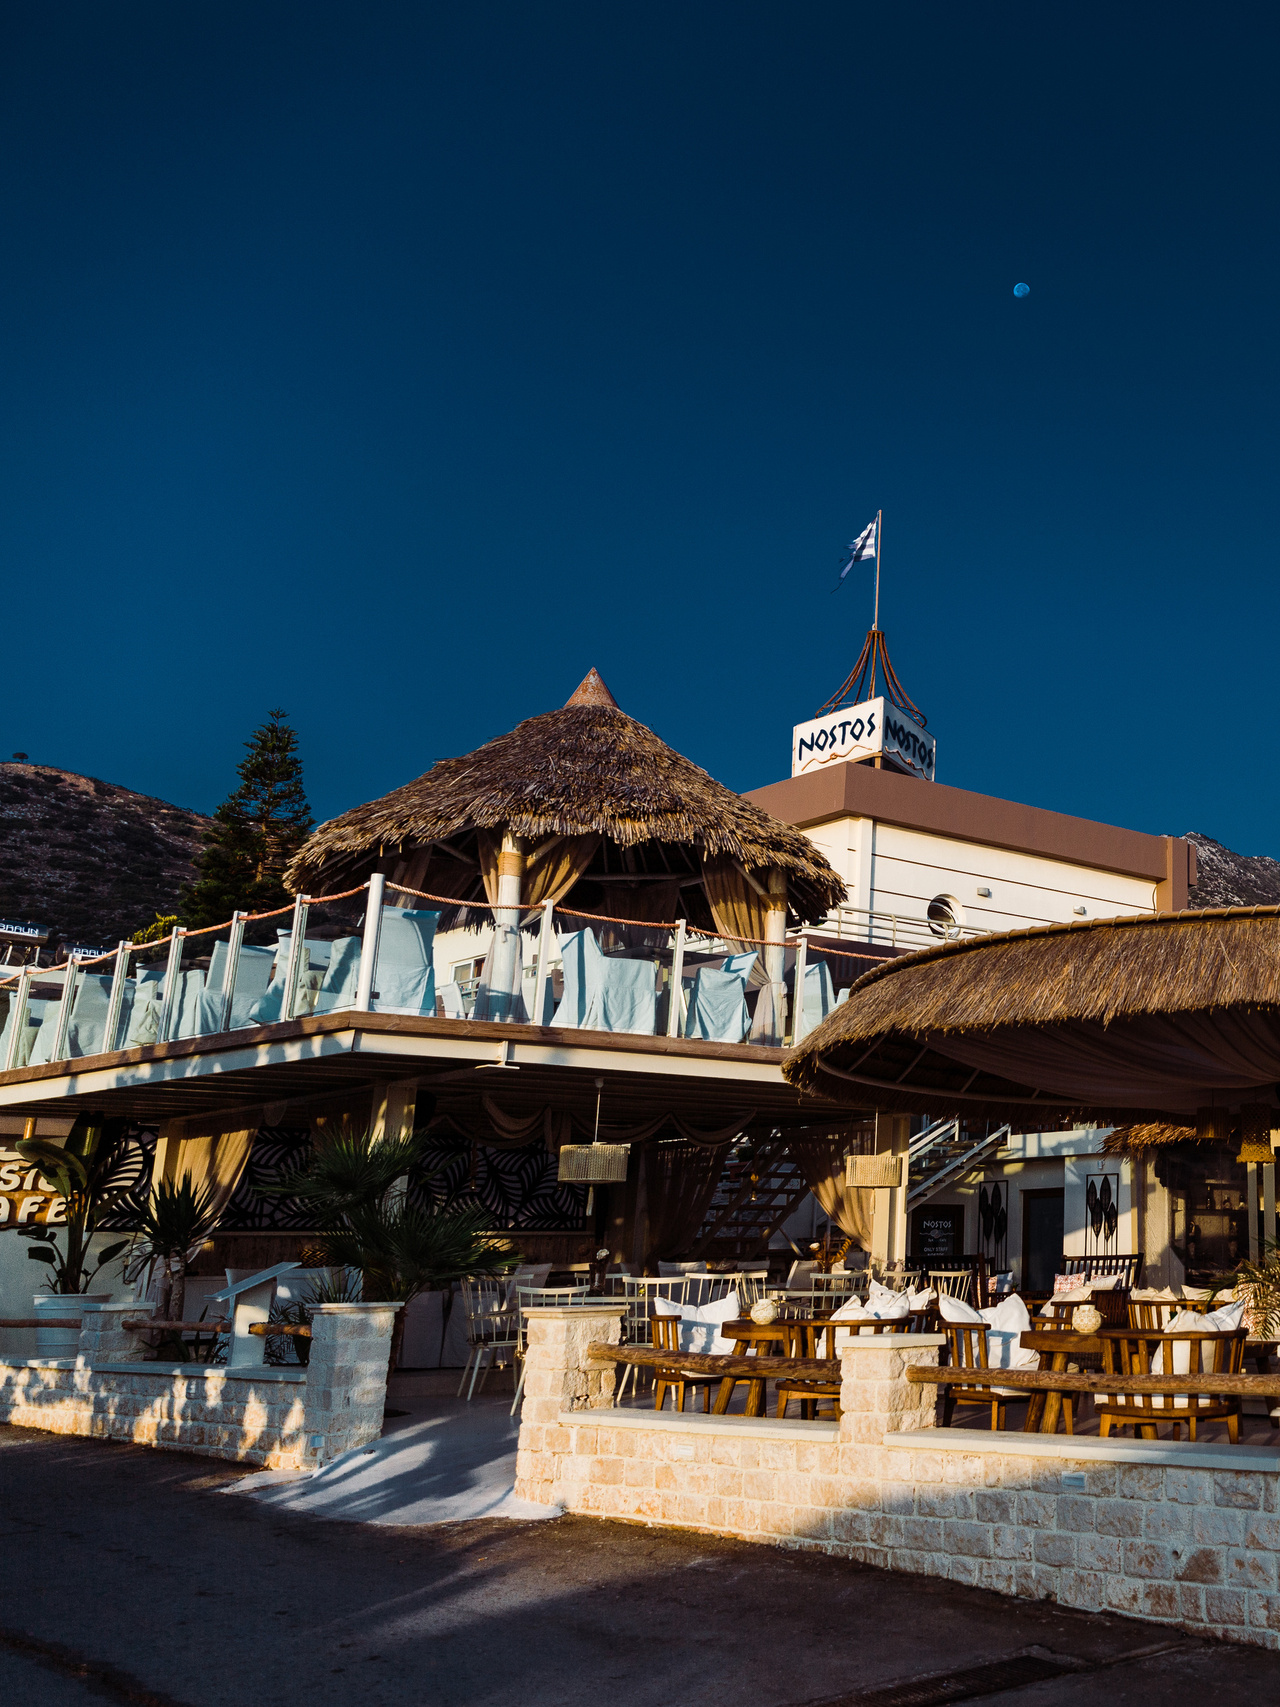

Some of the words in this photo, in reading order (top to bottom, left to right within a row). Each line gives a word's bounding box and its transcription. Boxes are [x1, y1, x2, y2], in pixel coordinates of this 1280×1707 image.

[799, 713, 876, 761] NOSTOS
[885, 716, 933, 769] NOSTOS
[923, 1220, 952, 1229] NOSTOS
